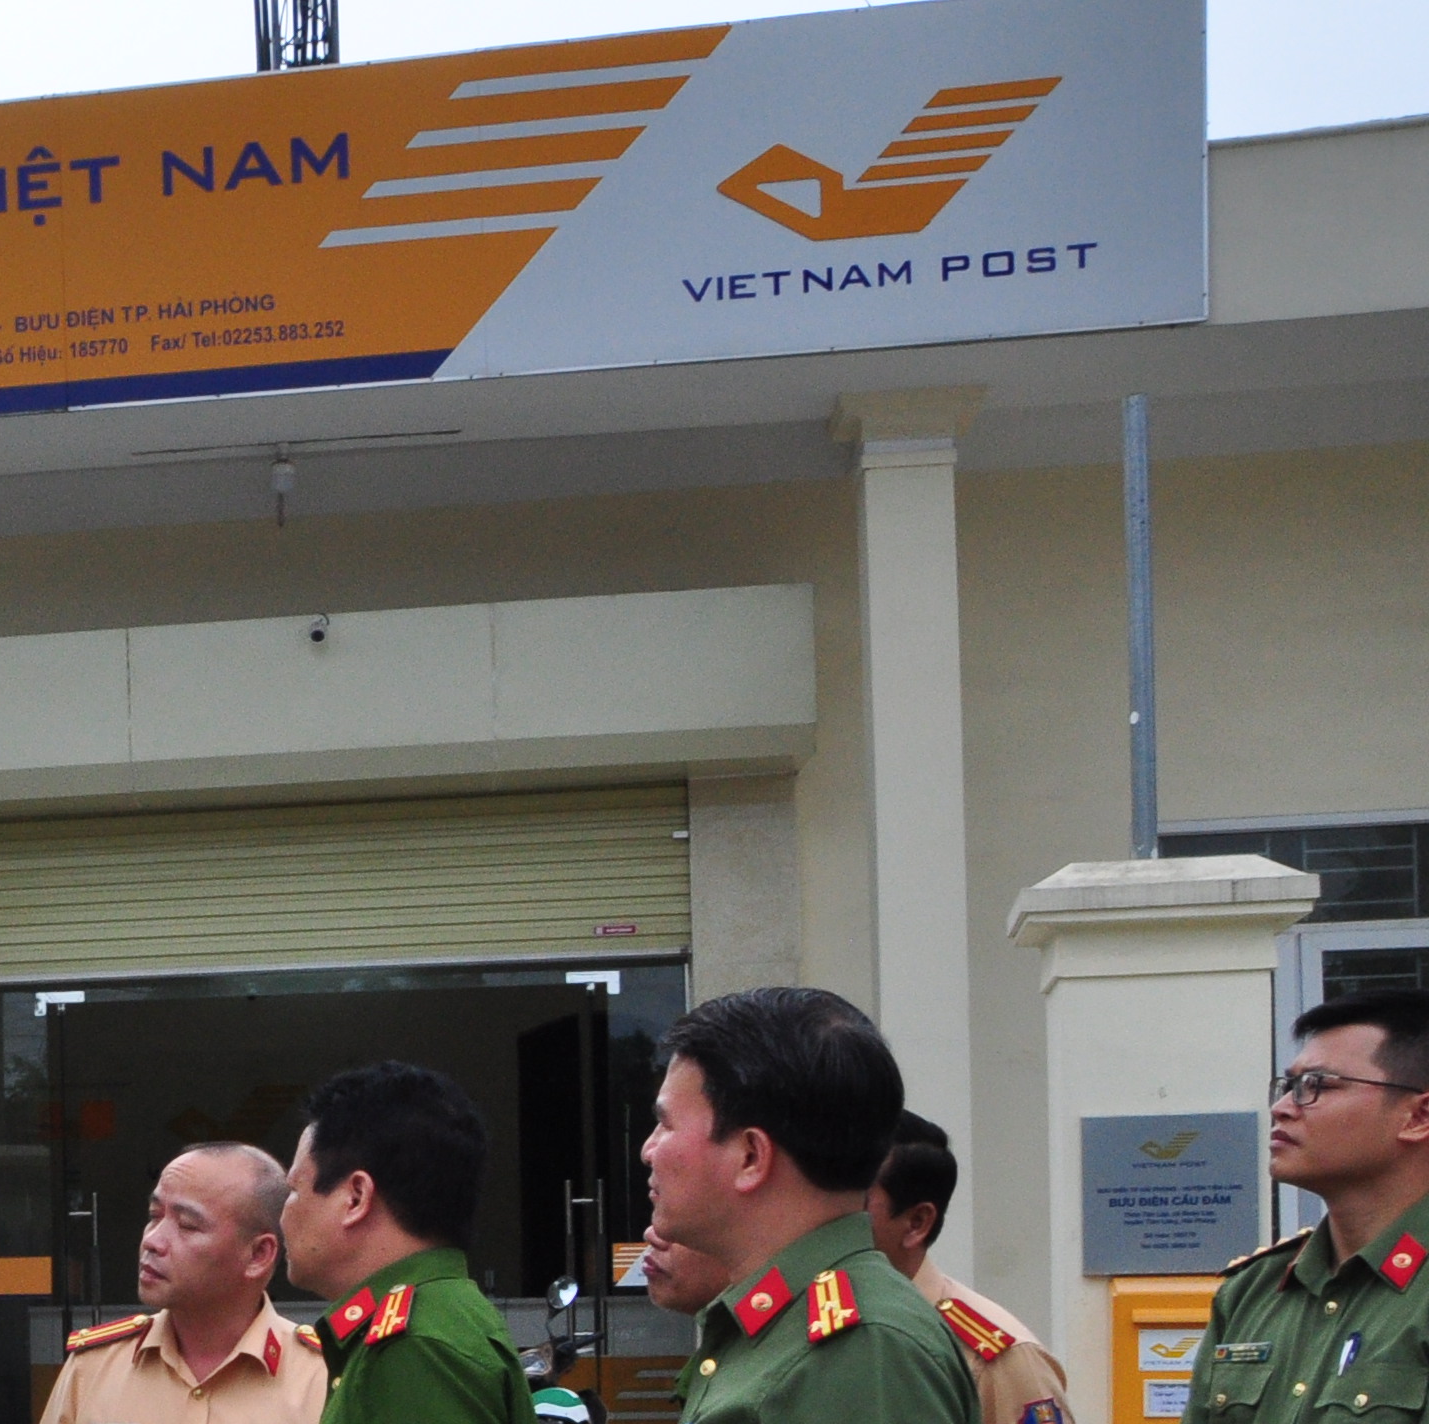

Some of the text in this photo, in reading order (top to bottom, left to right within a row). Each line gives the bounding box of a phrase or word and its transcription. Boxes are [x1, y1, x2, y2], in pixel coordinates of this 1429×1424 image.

[161, 132, 350, 196] NAM
[682, 242, 1098, 302] VIETNAM POST
[14, 313, 59, 333] BƯU
[66, 306, 114, 329] ĐIỆN
[70, 338, 128, 358] 185770
